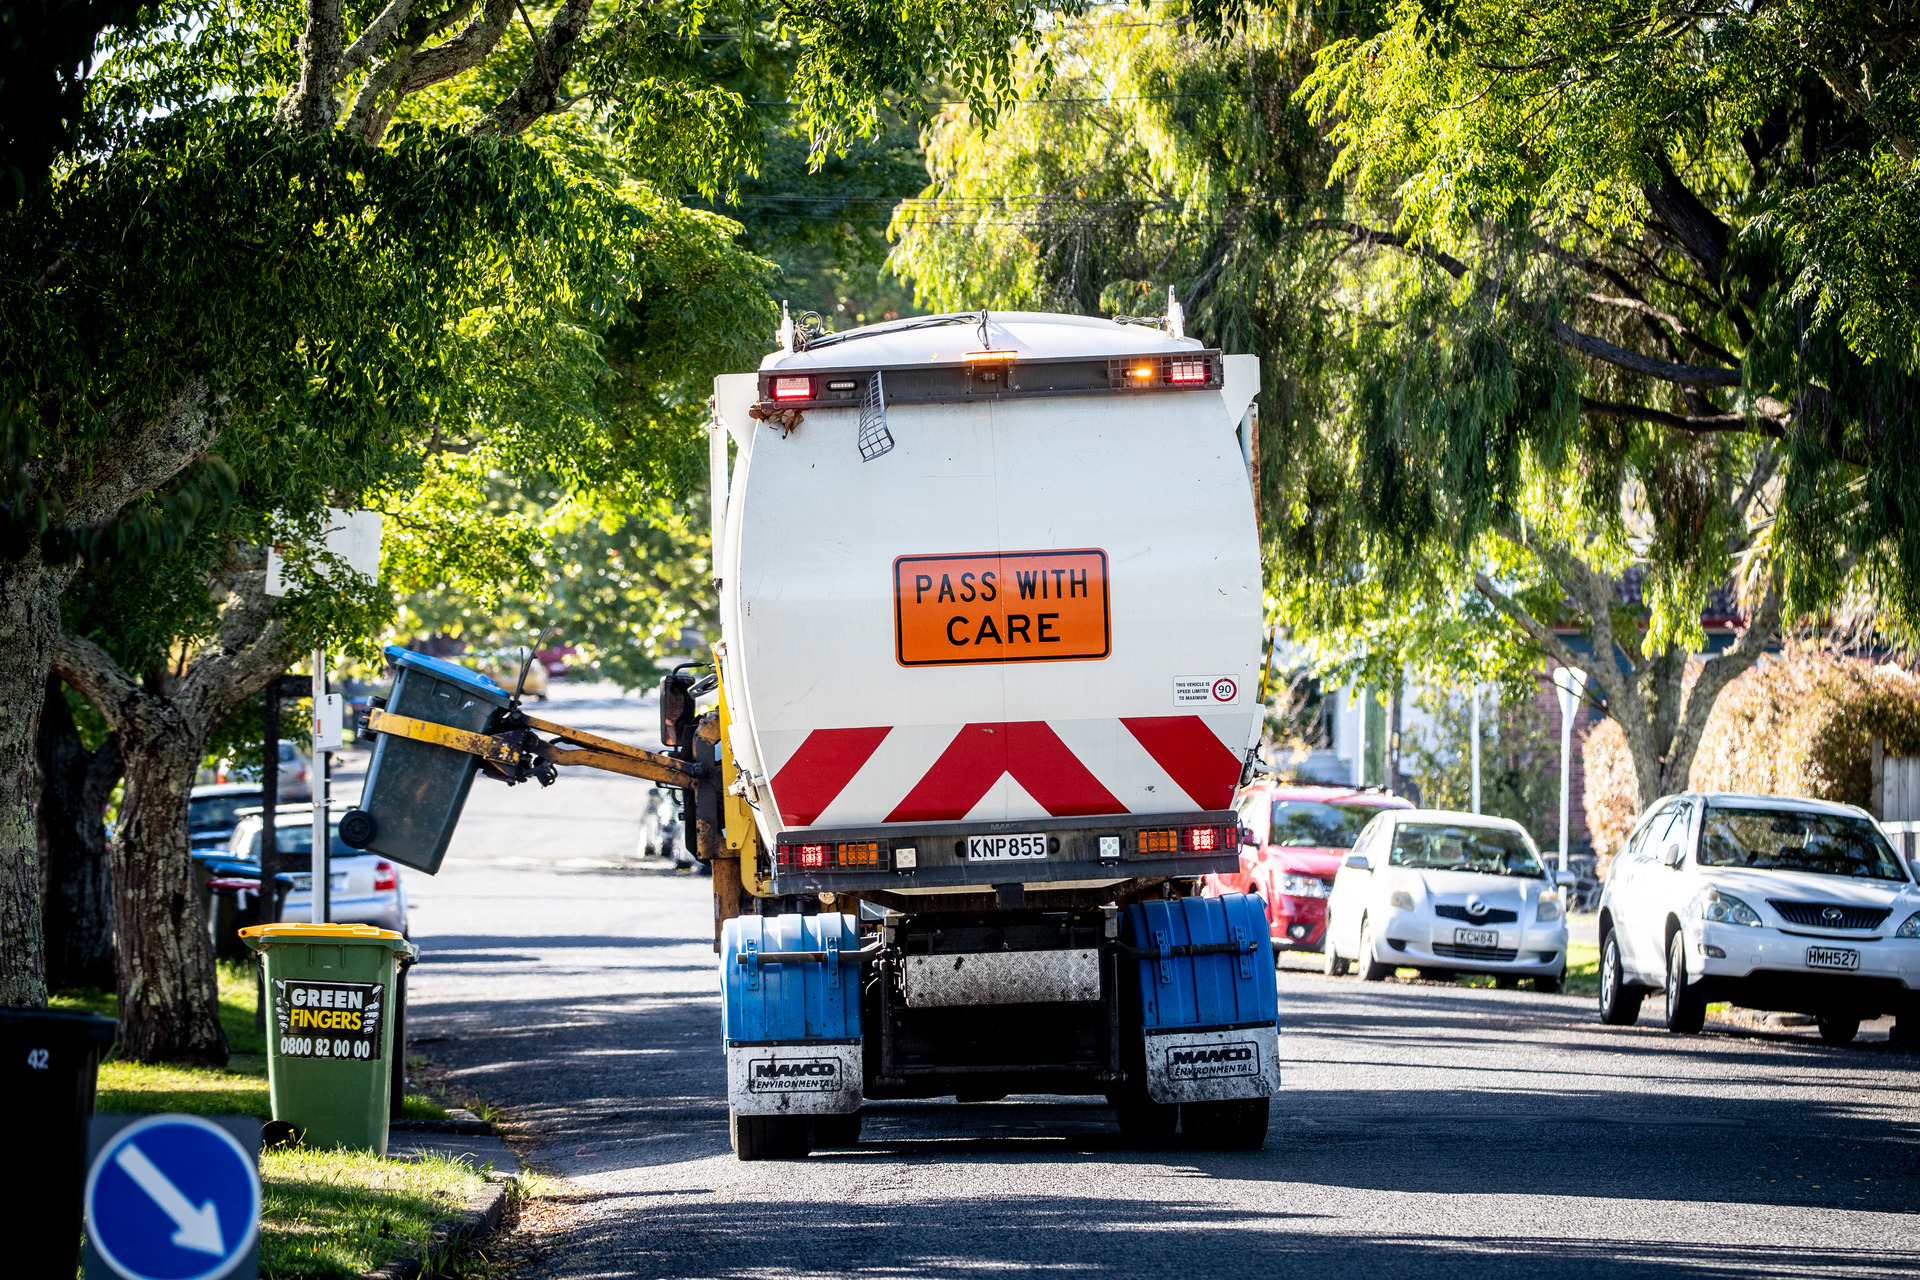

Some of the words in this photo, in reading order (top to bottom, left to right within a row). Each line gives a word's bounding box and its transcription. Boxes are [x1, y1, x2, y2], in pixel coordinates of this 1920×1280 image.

[915, 571, 997, 604] PASS
[1016, 568, 1088, 600] WITH
[946, 612, 1061, 647] CARE
[1218, 685, 1231, 694] 90
[970, 836, 1045, 858] KNP855
[1808, 950, 1858, 967] HMH527
[291, 988, 364, 1010] GREEN
[290, 1009, 362, 1030] FINGERS
[280, 1036, 312, 1056] 0800
[315, 1038, 330, 1057] 82
[333, 1039, 351, 1058] 00
[353, 1040, 371, 1059] 00
[27, 1048, 50, 1070] 42
[1174, 1063, 1253, 1077] ENVIRONMENTAL
[756, 1079, 836, 1089] ENVIRONMENTAL
